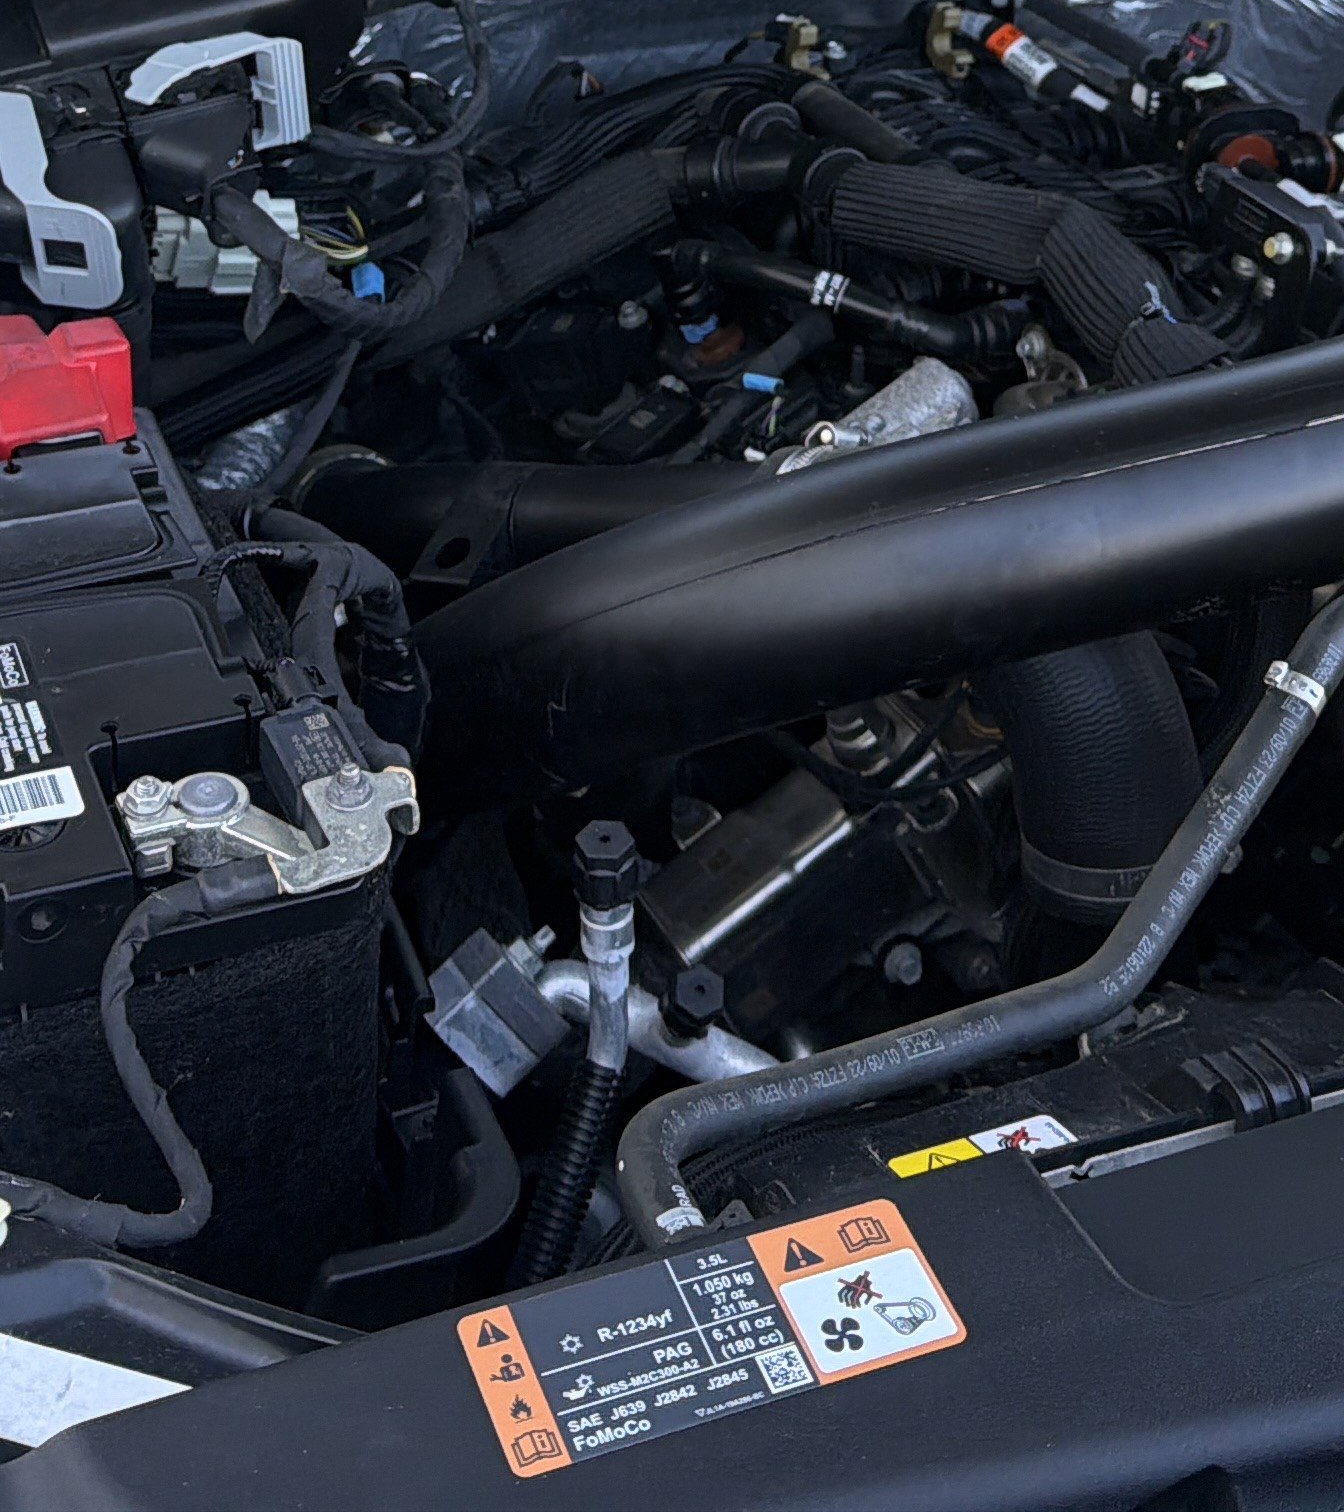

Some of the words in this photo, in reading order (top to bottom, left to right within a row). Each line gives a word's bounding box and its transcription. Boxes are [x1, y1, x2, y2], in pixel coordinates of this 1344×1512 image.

[1258, 716, 1297, 769] 01/09/23
[671, 1184, 693, 1207] RAD
[696, 1253, 729, 1271] 3.5L
[692, 1276, 731, 1297] 1.050
[731, 1271, 754, 1291] kg
[713, 1291, 727, 1306] 37
[731, 1290, 746, 1299] oz
[711, 1305, 735, 1320] 2.31
[737, 1299, 759, 1313] lbs
[597, 1308, 674, 1343] R-1234yf
[713, 1327, 735, 1343] 6.1
[738, 1322, 751, 1334] fl
[752, 1315, 774, 1331] oz
[653, 1342, 692, 1364] PAG
[721, 1336, 755, 1361] (180
[756, 1327, 784, 1349] cc)
[597, 1358, 700, 1397] WSS-M2C300-A2
[567, 1411, 603, 1433] SAE
[611, 1401, 647, 1421] J639
[654, 1385, 696, 1407] J2842
[707, 1368, 749, 1392] J2845
[572, 1419, 652, 1452] FoMoCo
